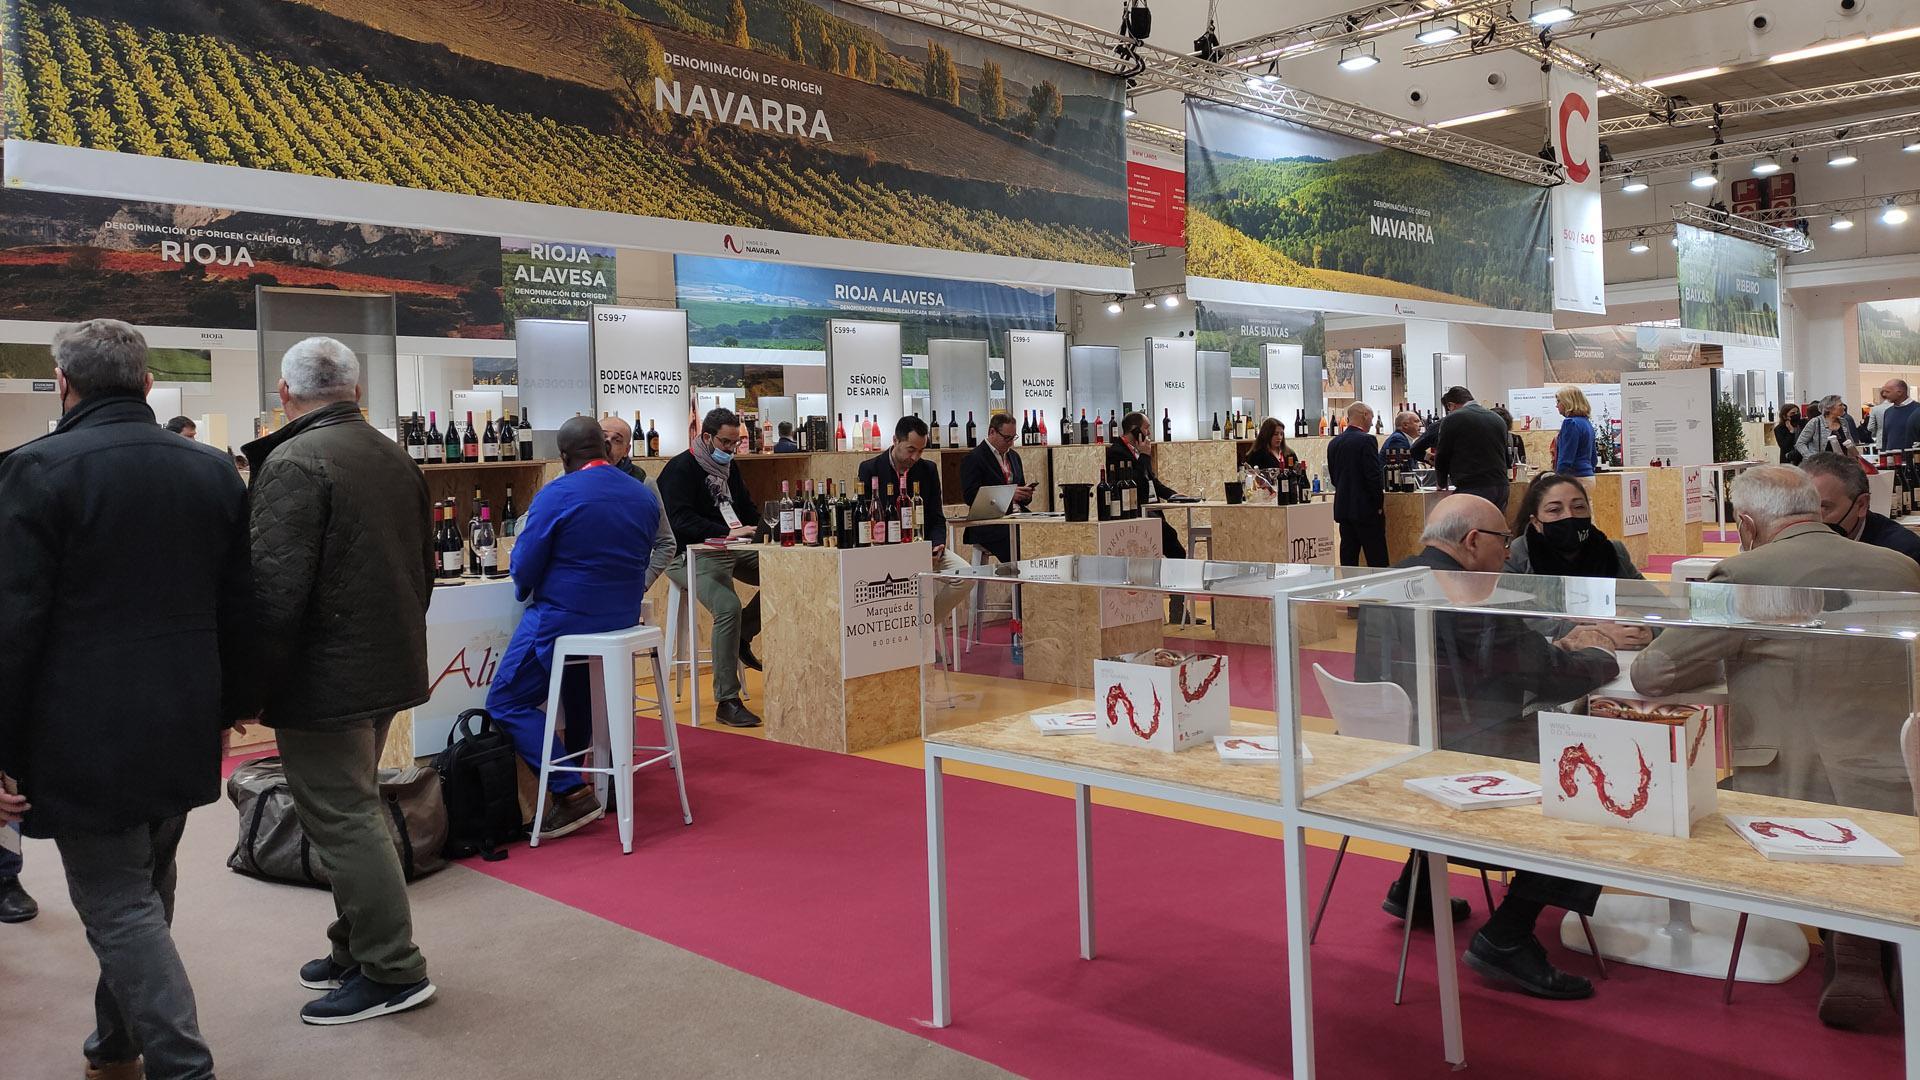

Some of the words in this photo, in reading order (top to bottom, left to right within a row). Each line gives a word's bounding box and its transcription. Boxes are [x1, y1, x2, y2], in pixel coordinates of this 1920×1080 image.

[664, 51, 759, 83] DENOMINACIÓN
[763, 73, 778, 87] DE
[781, 77, 823, 96] ORIGEN
[655, 76, 834, 142] NAVARRA
[1559, 92, 1591, 184] C
[1374, 199, 1408, 213] DENOMINACIÓN
[1415, 208, 1431, 217] ORIGEN
[104, 221, 188, 236] DENOMINACIÓN
[190, 229, 203, 237] DE
[206, 230, 244, 241] ORIGEN
[245, 233, 303, 246] CALIFICADA
[1370, 214, 1435, 245] NAVARRA
[161, 240, 255, 268] RIOJA
[530, 243, 591, 264] RIOJA
[746, 246, 780, 256] NAVARRA
[514, 265, 607, 287] ALAVESA
[1736, 278, 1760, 295] RIBEIRO
[514, 288, 570, 298] DENOMINACIÓN
[581, 292, 607, 300] ORIGEN
[835, 284, 879, 303] RIOJA
[882, 288, 945, 307] ALAVESA
[1685, 287, 1711, 304] BAIXAS
[530, 297, 572, 306] CALIFICADA
[840, 304, 876, 312] DENOMINACIÓN
[598, 313, 626, 322] C599-7
[834, 326, 856, 334] C599-6
[1240, 325, 1259, 336] RIAS
[1261, 326, 1288, 338] BAIXAS
[1574, 350, 1604, 358] SOMONTANO
[600, 370, 638, 380] BODEGA
[640, 372, 682, 381] MARQUES
[850, 374, 886, 384] SEÑORÍO
[604, 384, 615, 393] DE
[617, 384, 680, 394] MONTECIERZO
[1022, 379, 1046, 387] MALON
[1164, 381, 1185, 389] NEKEAS
[847, 388, 858, 396] DE
[860, 386, 890, 396] SARRÍA
[1025, 390, 1052, 398] ECHAIDE
[1625, 512, 1648, 527] ALZANIA
[866, 604, 902, 618] Marqués
[904, 602, 913, 611] de
[872, 636, 908, 647] BODEGA
